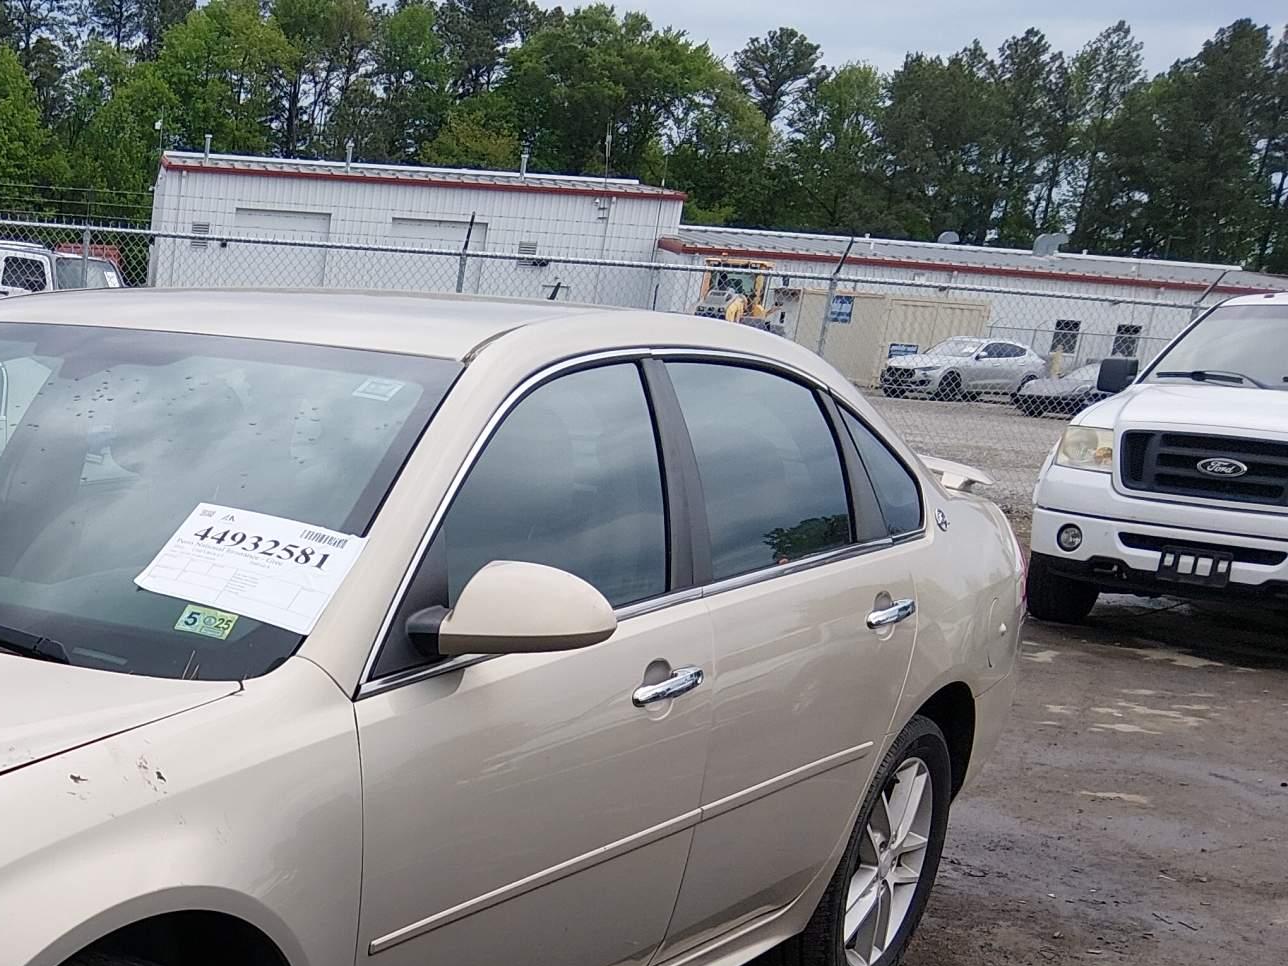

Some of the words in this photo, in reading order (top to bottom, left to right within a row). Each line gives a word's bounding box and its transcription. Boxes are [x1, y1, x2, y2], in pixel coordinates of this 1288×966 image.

[1207, 460, 1236, 473] Ford
[194, 526, 331, 570] 44932581
[184, 611, 200, 626] 5
[214, 617, 232, 630] 25
